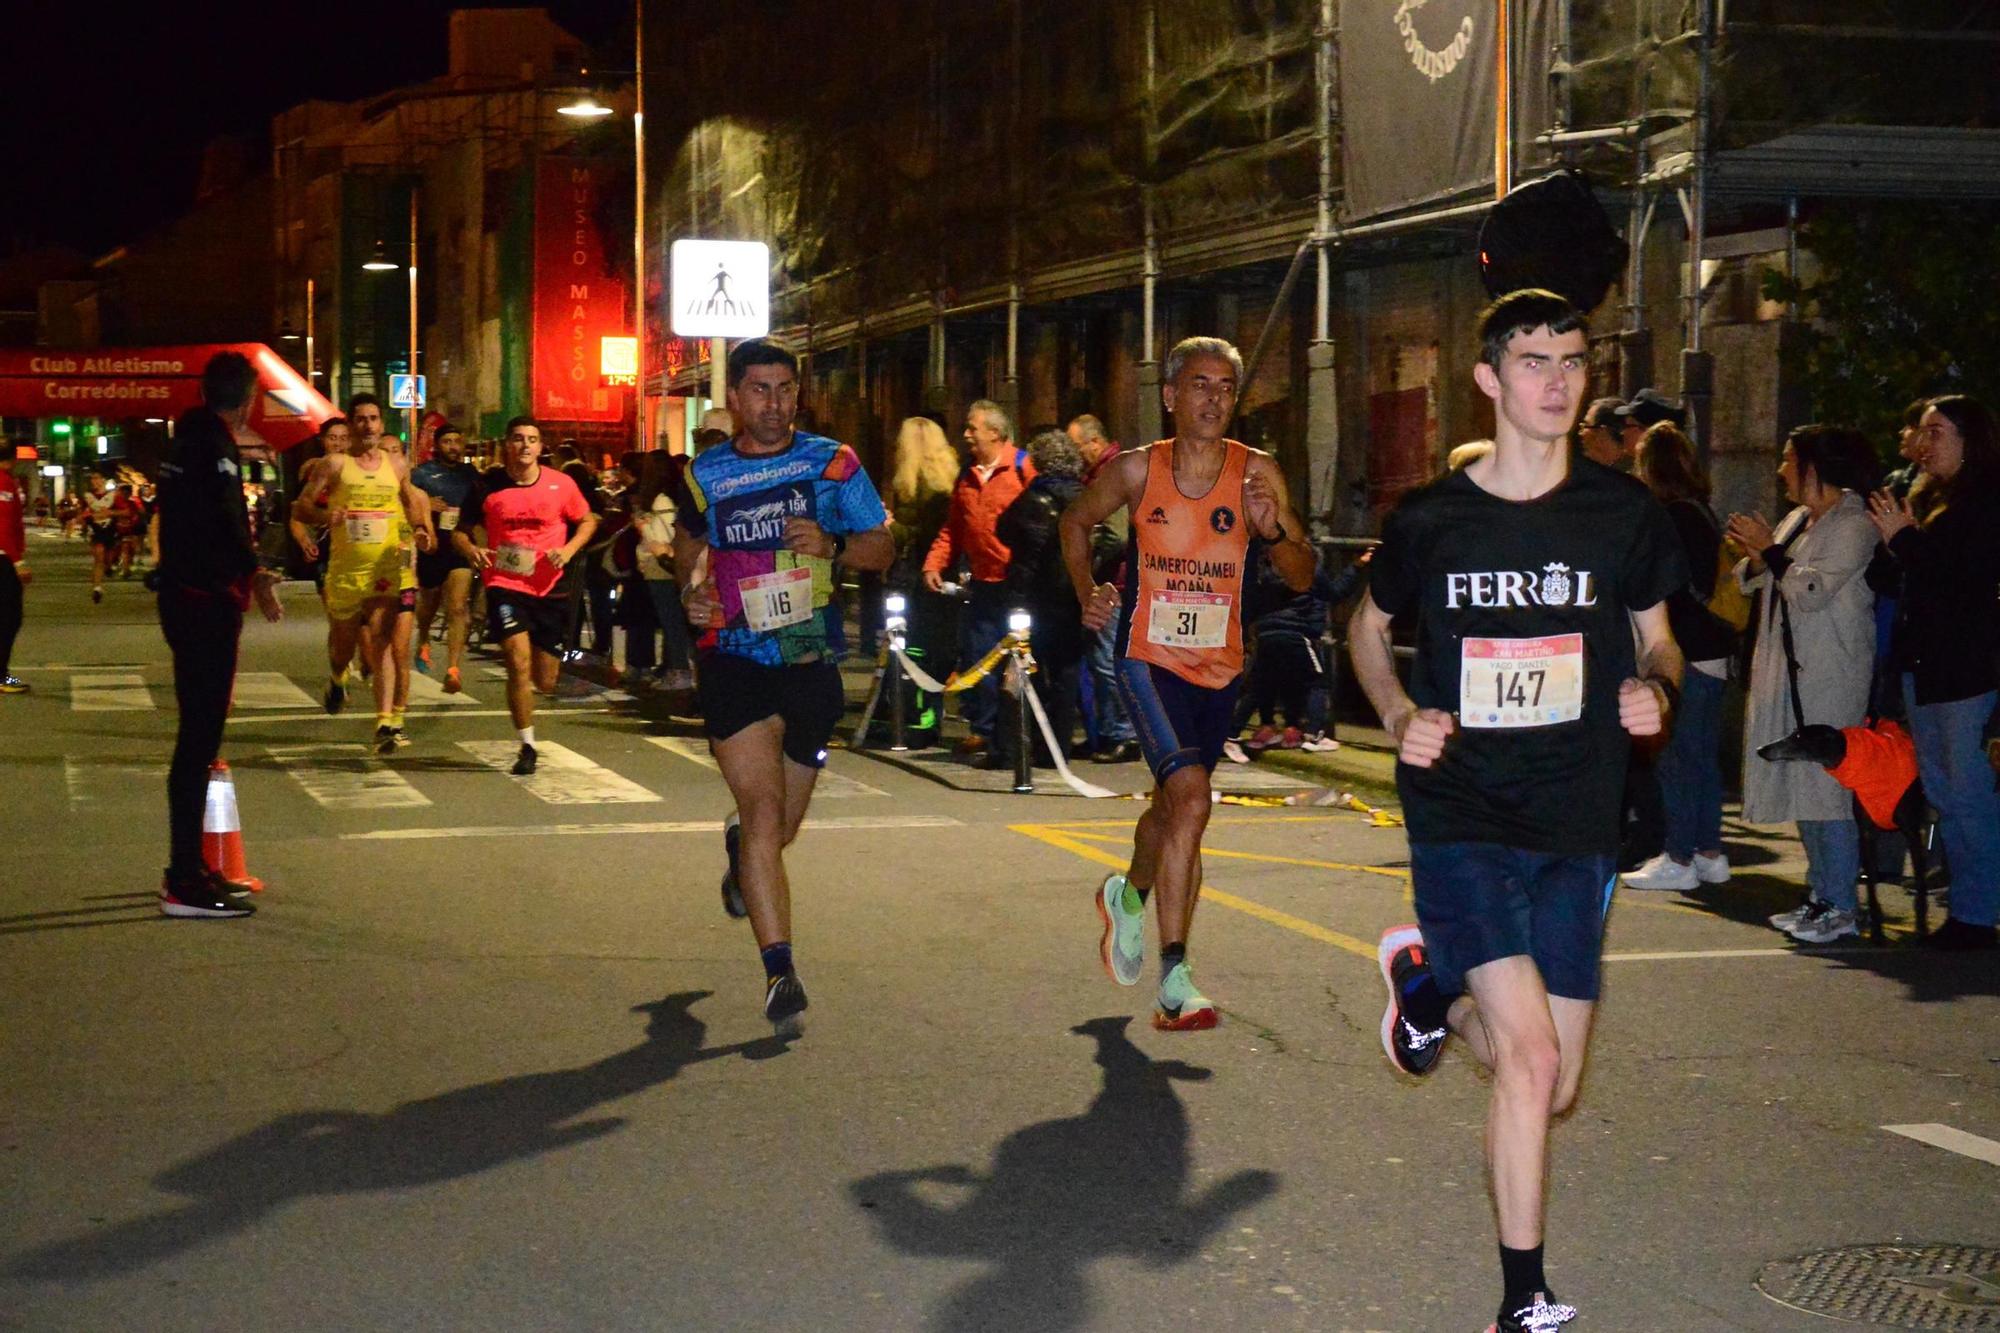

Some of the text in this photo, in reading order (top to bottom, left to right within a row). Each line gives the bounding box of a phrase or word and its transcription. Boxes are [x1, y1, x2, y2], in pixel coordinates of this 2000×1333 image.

[570, 168, 589, 382] MUSEO MASSÓ
[30, 357, 185, 373] Club Atletismo
[44, 382, 171, 399] Corredoiras
[788, 499, 808, 512] 15K
[1145, 553, 1236, 578] SAMERTOLAMEU
[1166, 577, 1214, 593] MOAÑA
[1177, 612, 1197, 636] 31
[1496, 670, 1546, 708] 147
